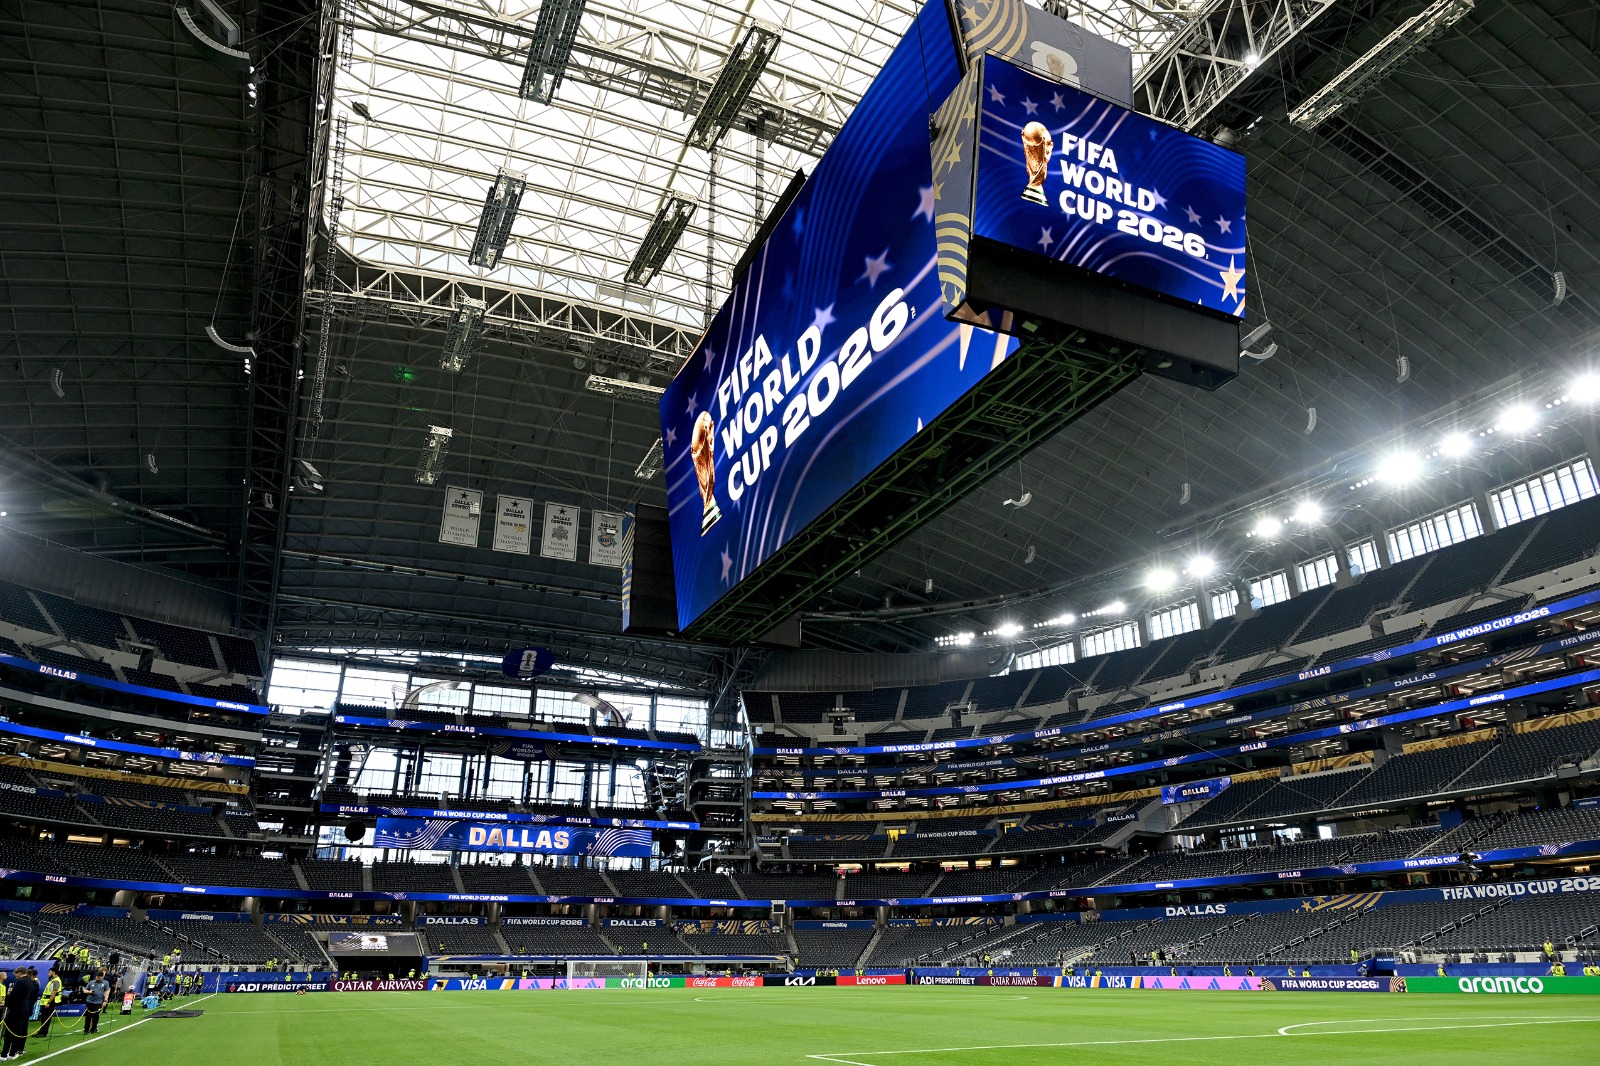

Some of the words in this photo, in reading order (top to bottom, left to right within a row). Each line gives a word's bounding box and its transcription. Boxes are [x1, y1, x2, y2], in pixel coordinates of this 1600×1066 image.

[1061, 132, 1119, 174] FIFA
[1059, 159, 1157, 212] WORLD
[1059, 190, 1113, 224] CUP
[1117, 209, 1207, 259] 2026
[717, 333, 773, 421] FIFA
[721, 325, 822, 459] WORLD
[727, 425, 778, 501] CUP
[782, 287, 909, 449] 2026
[1437, 632, 1457, 645] FIFA
[1457, 622, 1492, 640] WORLD
[1492, 617, 1513, 630] CUP
[1513, 607, 1551, 624] 2026
[1560, 636, 1578, 647] FIFA
[39, 664, 77, 680] DALLAS
[1298, 665, 1331, 680] DALLAS
[1394, 671, 1437, 687] DALLAS
[444, 723, 475, 733] DALLAS
[1034, 727, 1061, 738] DALLAS
[776, 747, 804, 755] DALLAS
[883, 745, 898, 753] FIFA
[898, 744, 921, 752] WORLD
[920, 742, 934, 751] CUP
[934, 741, 957, 749] 2026
[1080, 743, 1110, 754] DALLAS
[1239, 740, 1268, 753] DALLAS
[837, 767, 868, 775] DALLAS
[1039, 778, 1053, 786] FIFA
[1053, 775, 1073, 784] WORLD
[1072, 774, 1085, 782] CUP
[1084, 770, 1105, 780] 2026
[0, 782, 11, 790] UP
[11, 784, 37, 794] 2026
[1181, 785, 1210, 797] DALLAS
[339, 805, 369, 813] DALLAS
[433, 810, 448, 818] FIFA
[484, 812, 508, 820] 2026
[1107, 812, 1136, 823] DALLAS
[468, 827, 570, 850] DALLAS
[1404, 860, 1418, 868] FIFA
[1418, 858, 1443, 866] WORLD
[1442, 856, 1456, 864] CUP
[1277, 871, 1302, 879] DALLAS
[1442, 886, 1474, 901] FIFA
[1472, 883, 1526, 899] WORLD
[1527, 880, 1558, 895] CUP
[1165, 903, 1227, 918] DALLAS
[426, 917, 479, 925] DALLAS
[523, 918, 546, 926] WORLD
[610, 919, 657, 927] DALLAS
[334, 980, 373, 991] QATAR
[376, 980, 424, 991] AIRWAYS
[460, 980, 487, 991] VISA
[621, 977, 670, 988] aramco
[856, 976, 887, 986] Lenovo
[919, 976, 934, 985] ADI
[935, 976, 975, 985] PREDICTSTREET
[990, 976, 1010, 986] QATAR
[1011, 976, 1038, 986] AIRWAYS
[1068, 976, 1086, 988] VISA
[1107, 976, 1126, 988] VISA
[1281, 979, 1300, 989] FIFA
[1299, 979, 1328, 989] WORLD
[1328, 979, 1346, 989] CUP
[1346, 979, 1377, 989] 2026
[1458, 977, 1544, 994] aramco
[237, 983, 260, 992] ADI
